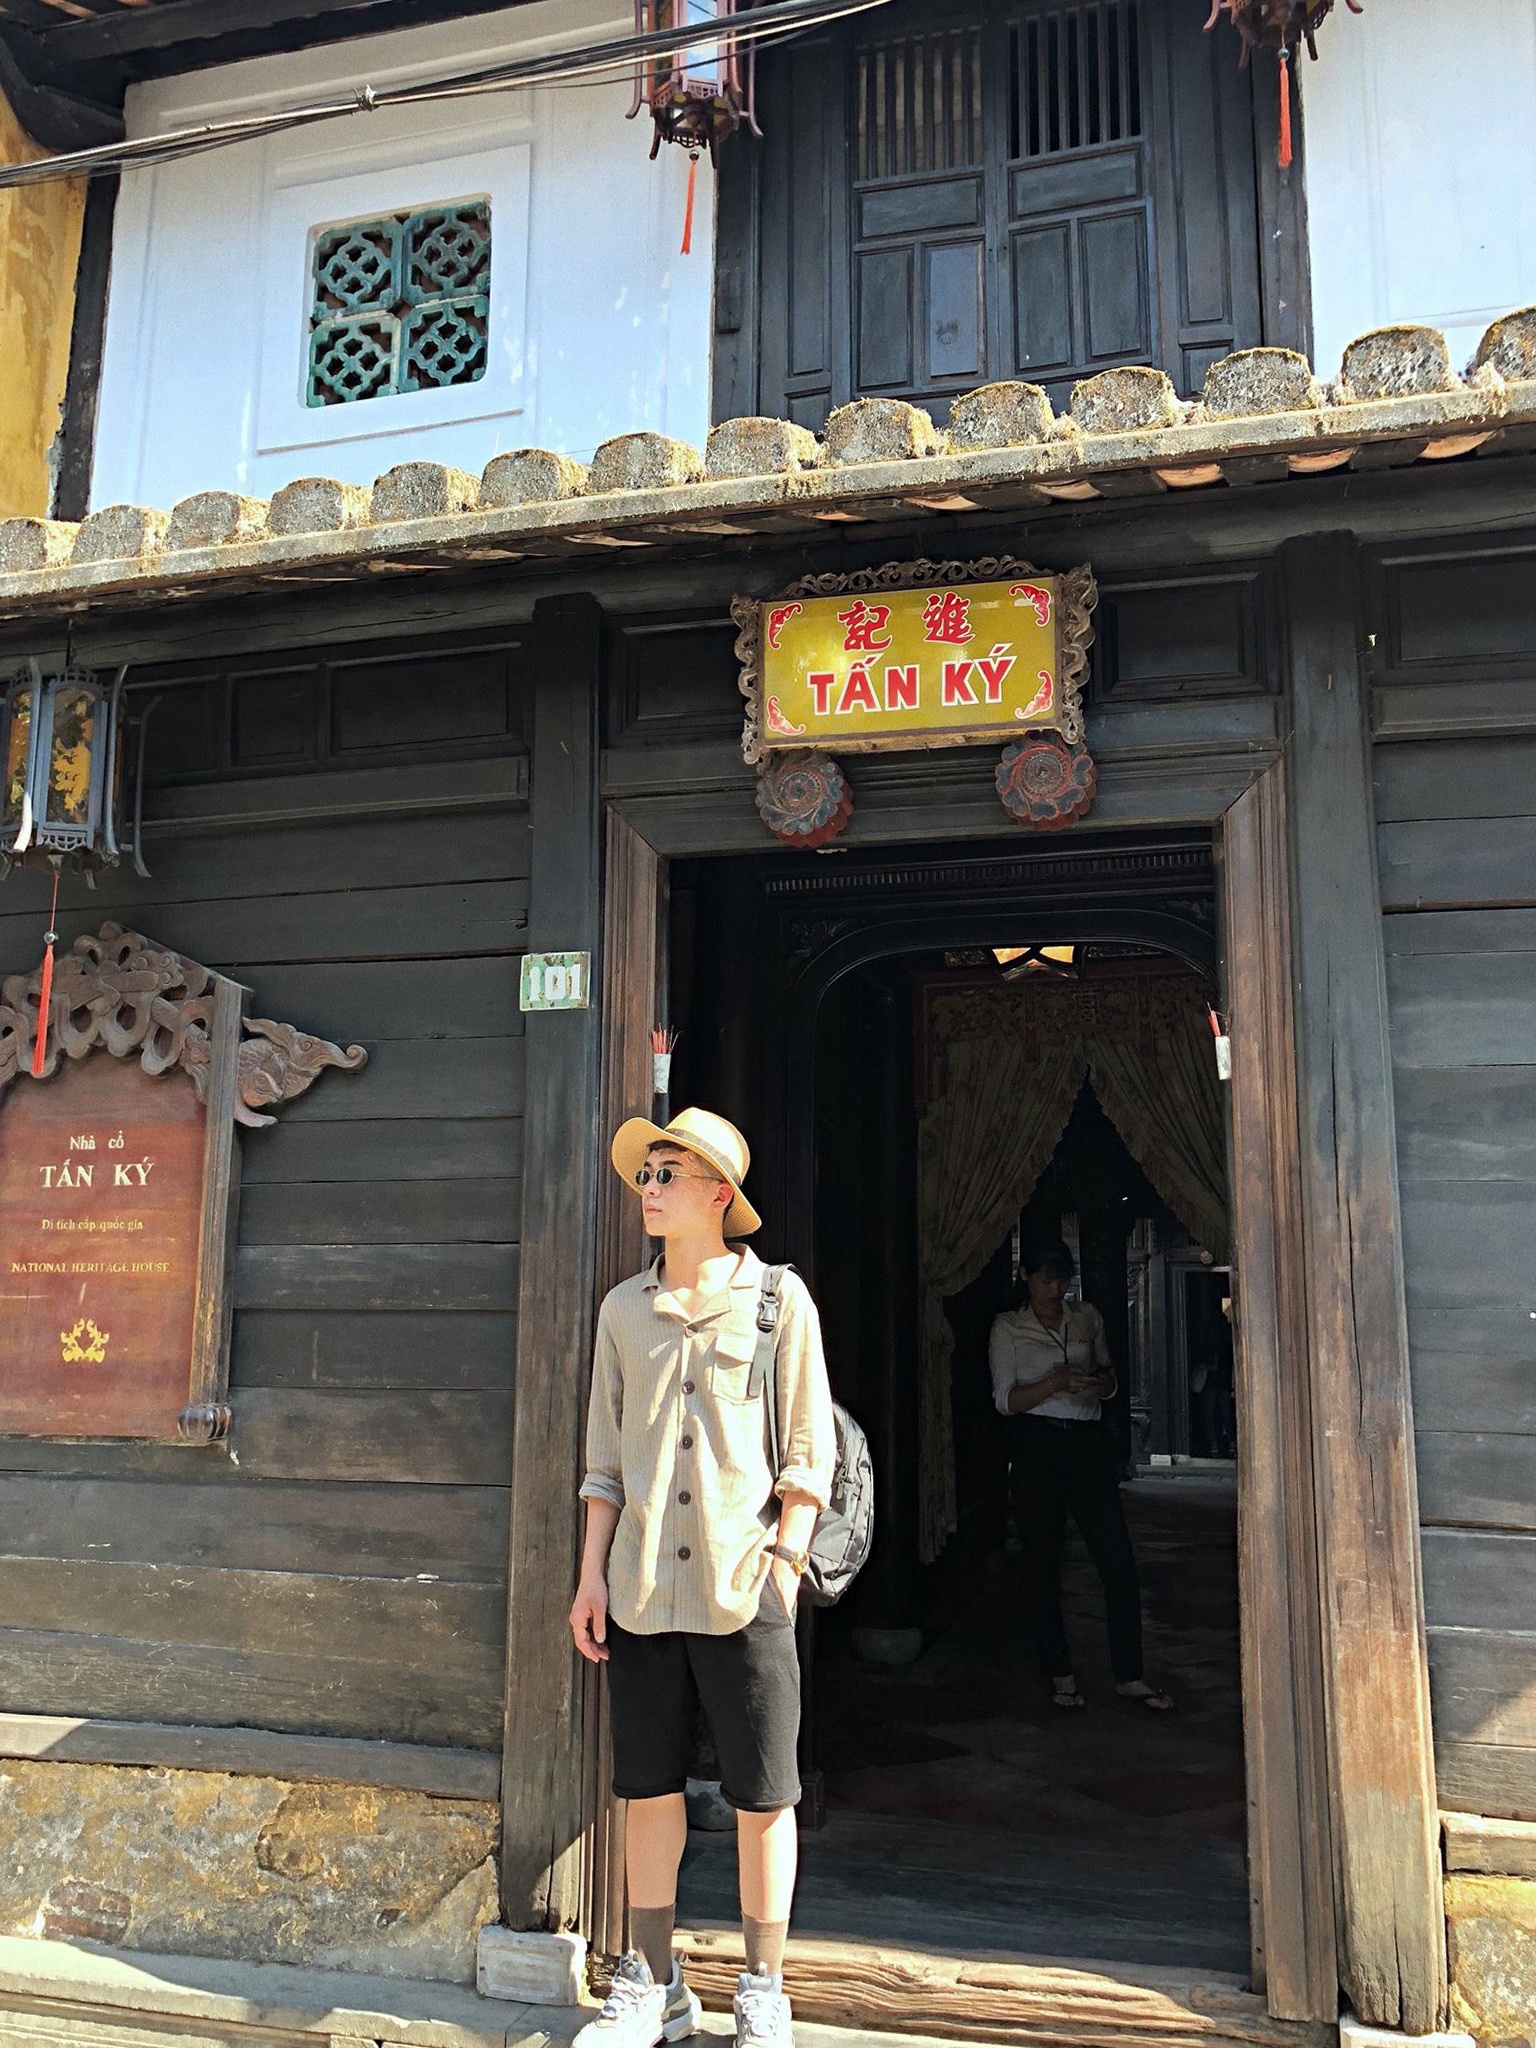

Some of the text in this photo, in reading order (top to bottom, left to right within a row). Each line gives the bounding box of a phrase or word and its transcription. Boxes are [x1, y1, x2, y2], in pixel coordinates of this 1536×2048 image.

[807, 642, 1017, 716] TẤN KÝ
[529, 963, 581, 1002] 101
[69, 1129, 124, 1150] Nhà cổ
[40, 1156, 155, 1188] TẤN KÝ
[56, 1217, 75, 1230] tích
[78, 1215, 96, 1232] cấp
[99, 1215, 125, 1232] quốc
[11, 1262, 170, 1273] NATIONAL HERITAGE HOUSE
